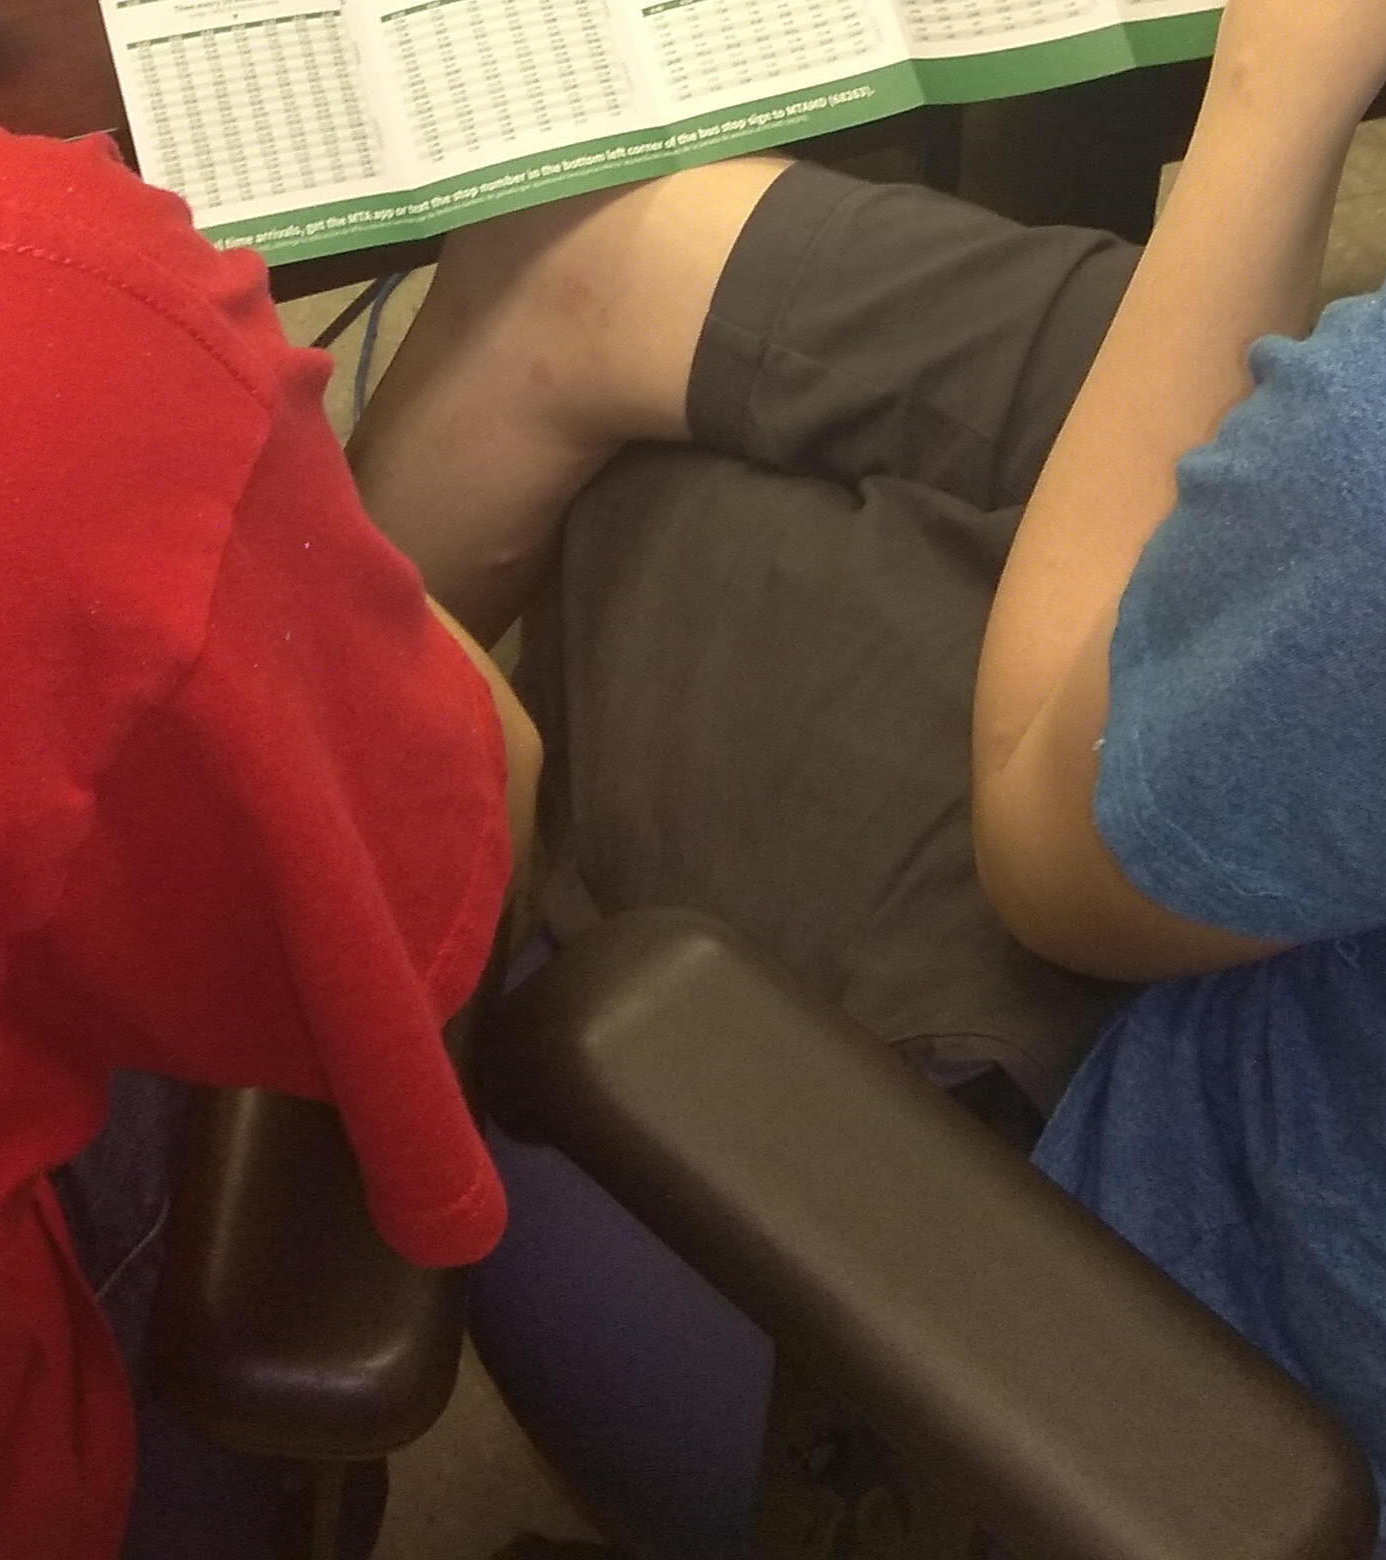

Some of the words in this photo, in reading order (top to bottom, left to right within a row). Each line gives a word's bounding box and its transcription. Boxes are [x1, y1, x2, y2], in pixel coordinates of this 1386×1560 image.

[255, 225, 307, 245] arrivals,
[305, 220, 326, 235] get
[326, 214, 348, 229] the
[347, 209, 374, 225] MTA
[373, 207, 395, 222] app
[394, 205, 408, 218] or
[408, 200, 430, 215] text
[430, 195, 452, 209] the
[452, 185, 480, 202] stop
[479, 171, 527, 193] number
[527, 166, 541, 180] in
[540, 161, 562, 177] the
[561, 152, 606, 172] bottom
[606, 146, 627, 161] left
[627, 140, 664, 157] corner
[663, 136, 678, 150] of
[677, 130, 698, 146] the
[698, 124, 722, 140] bus
[721, 117, 747, 134] stop
[746, 111, 772, 128] sign
[771, 107, 785, 121] to
